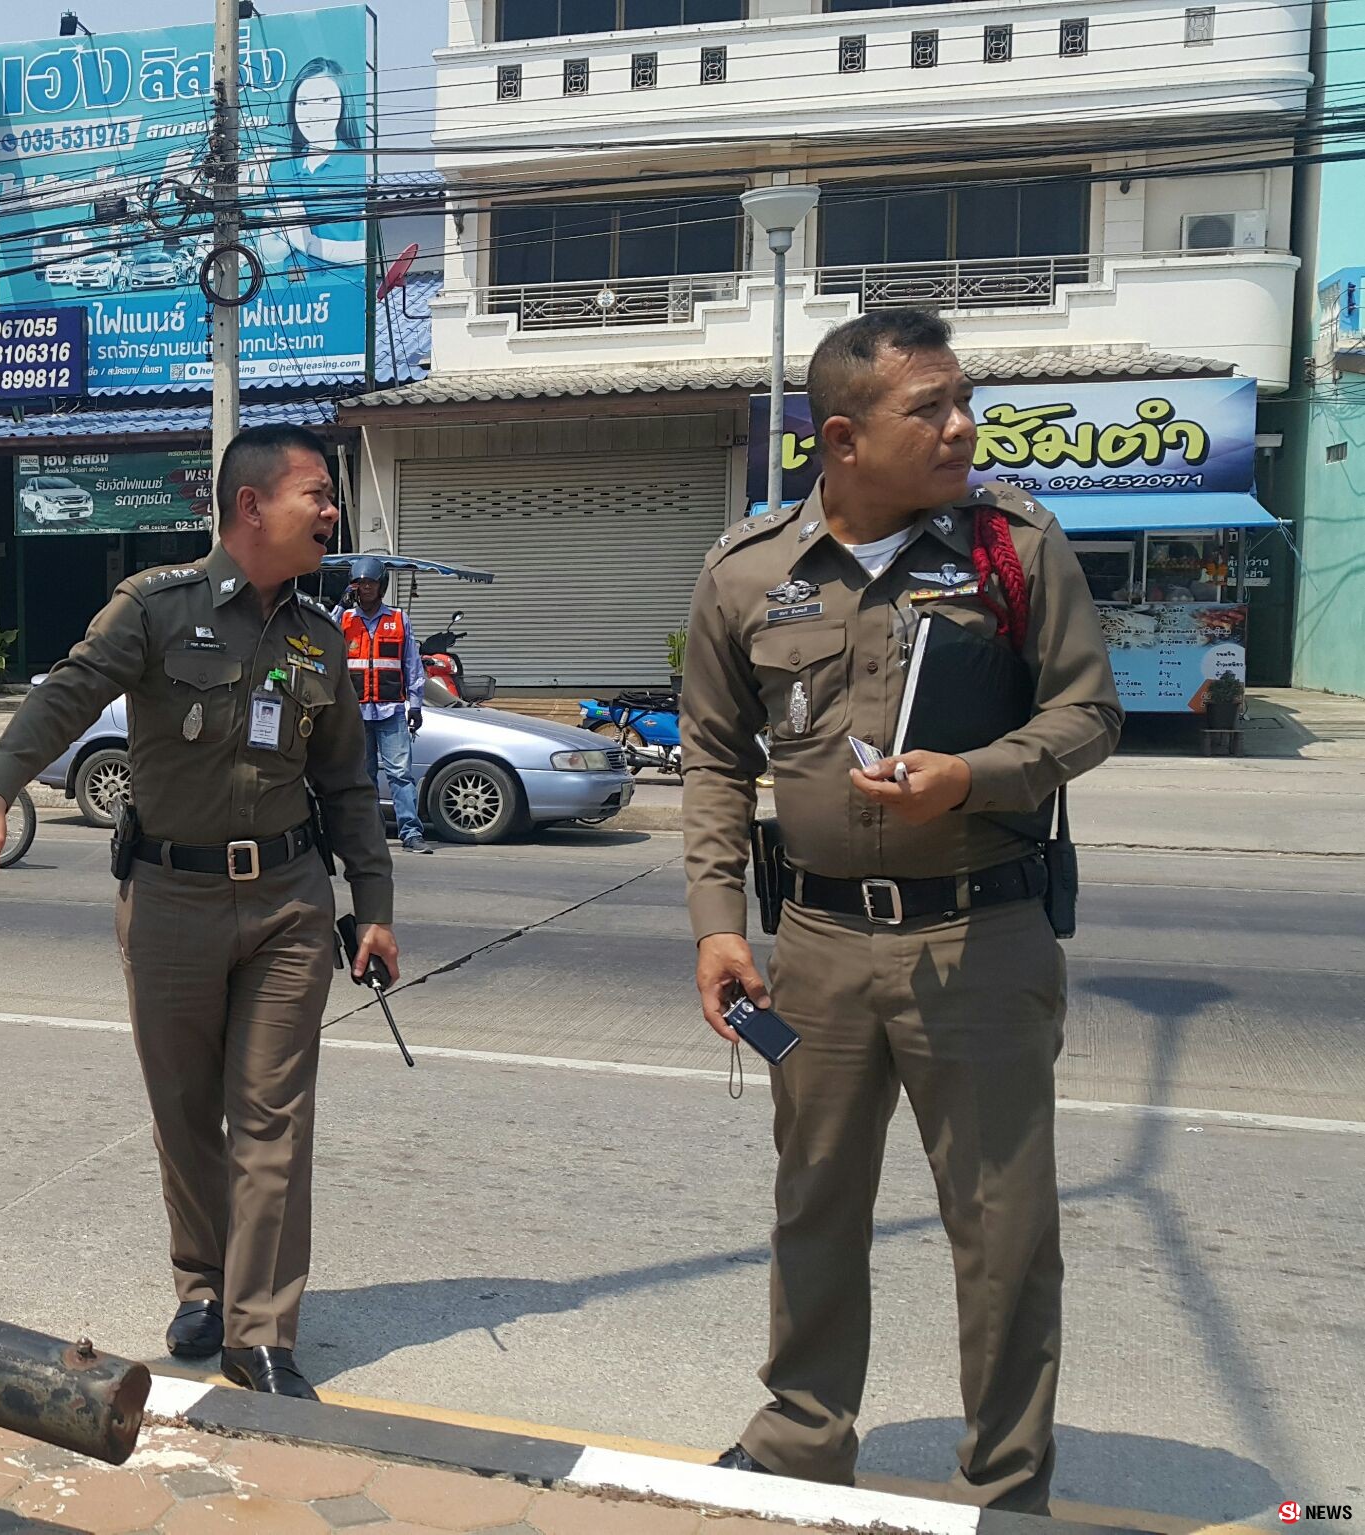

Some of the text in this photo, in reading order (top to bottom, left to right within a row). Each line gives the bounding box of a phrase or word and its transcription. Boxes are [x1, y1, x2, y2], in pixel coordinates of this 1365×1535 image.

[2, 46, 132, 116] เฮง
[20, 123, 131, 153] 035-531975
[1049, 473, 1204, 489] 096-2520971
[383, 622, 396, 630] 65
